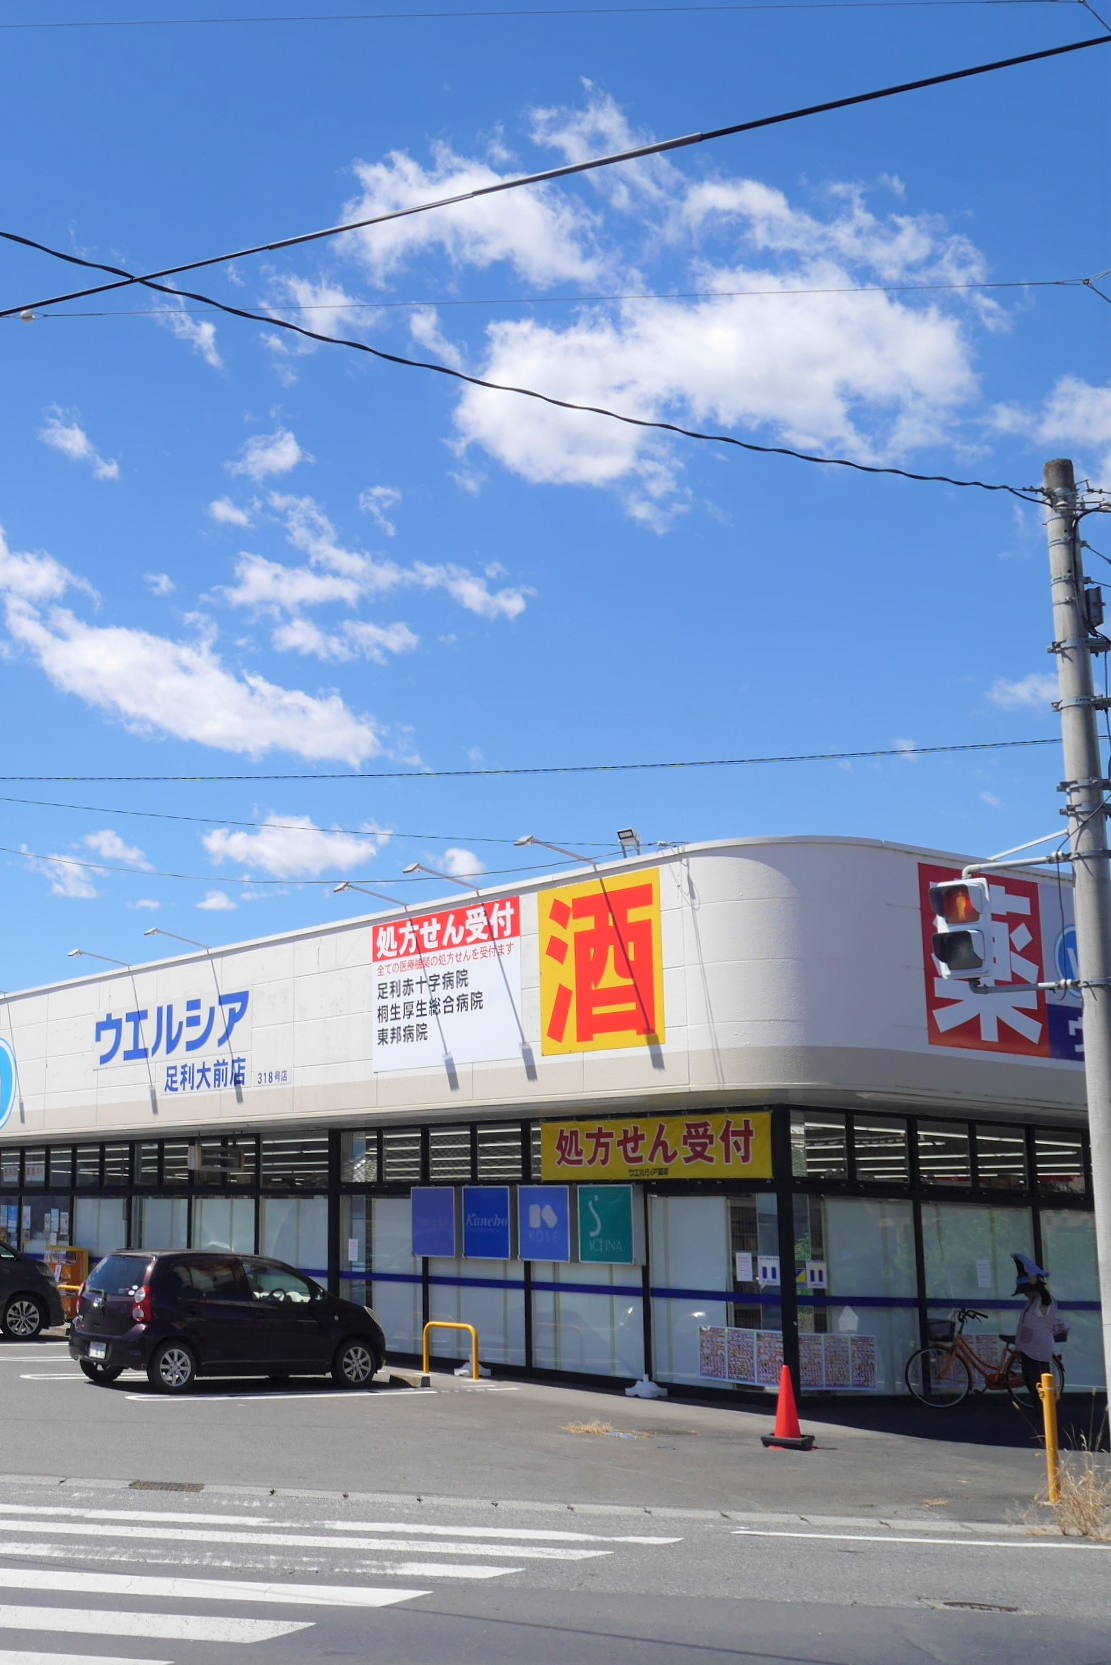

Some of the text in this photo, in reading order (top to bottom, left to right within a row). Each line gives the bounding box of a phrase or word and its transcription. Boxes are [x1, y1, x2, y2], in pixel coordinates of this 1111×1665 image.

[375, 901, 515, 960] 処方せん受付
[377, 942, 515, 977] 全ての医療機関の処方せんを受付ます
[545, 882, 656, 1044] 酒
[377, 969, 469, 1000] 足利赤十字病院
[377, 991, 484, 1024] 桐生厚生総合病院
[95, 990, 250, 1066] ウエルシア
[377, 1023, 429, 1046] 東邦病院
[164, 1057, 247, 1093] 足利大前店
[554, 1117, 755, 1168] 処方せん受付
[465, 1213, 508, 1227] Kanebo
